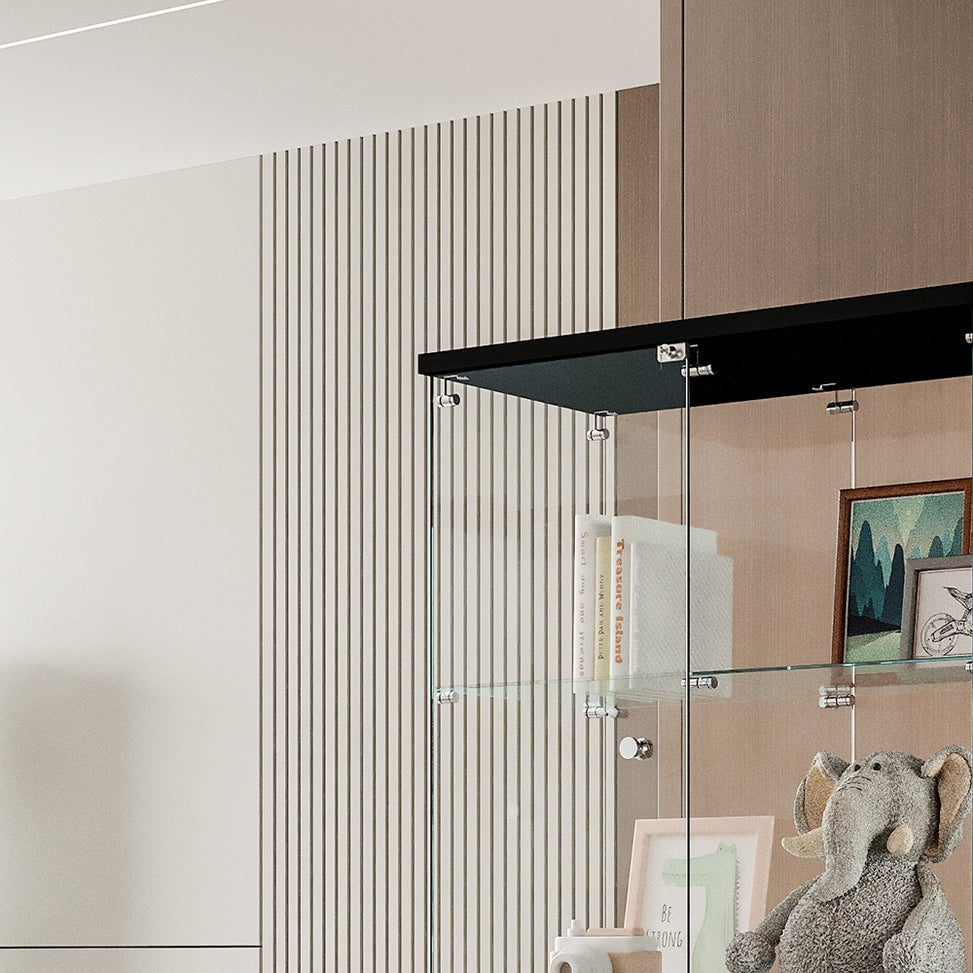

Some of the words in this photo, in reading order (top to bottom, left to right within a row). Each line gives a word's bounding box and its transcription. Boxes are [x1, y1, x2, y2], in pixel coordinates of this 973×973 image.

[615, 539, 625, 610] Treasure
[615, 615, 624, 664] Island
[661, 904, 672, 923] BE
